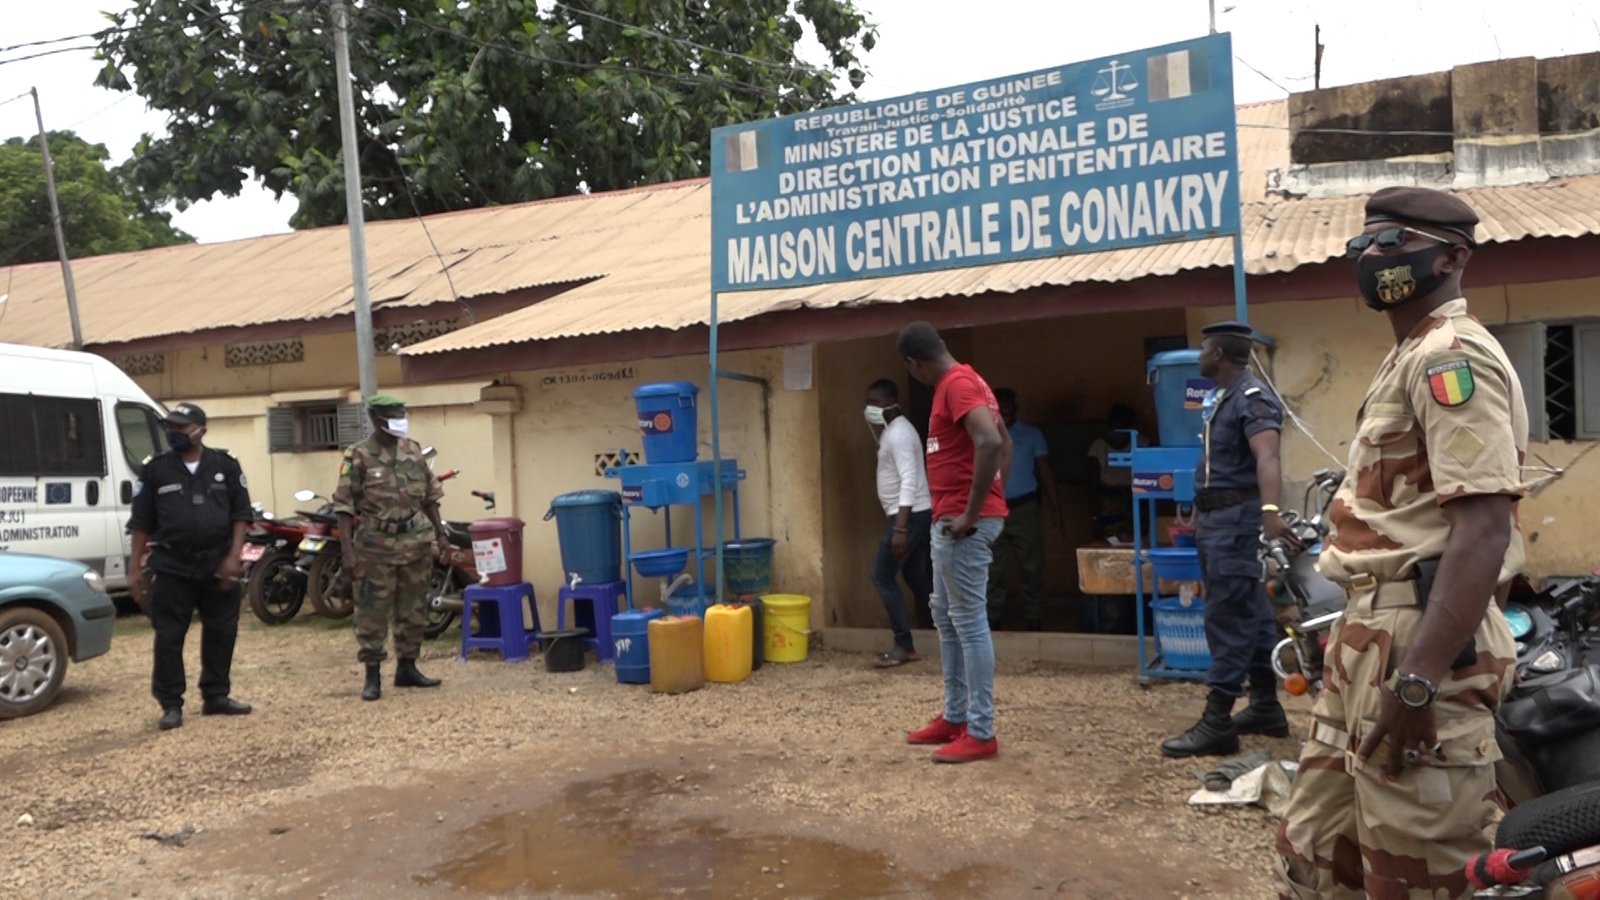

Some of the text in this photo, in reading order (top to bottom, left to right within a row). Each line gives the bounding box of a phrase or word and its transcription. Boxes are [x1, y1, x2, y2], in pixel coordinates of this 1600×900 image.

[784, 130, 898, 165] MINISTERE
[904, 125, 933, 147] DE
[941, 118, 970, 140] LA
[977, 96, 1077, 134] JUSTICE
[794, 71, 1062, 132] REPUBLIQUE DE GUINEE
[736, 131, 1226, 225] L'ADMINISTRATION PENITENTIAIRE
[779, 113, 1149, 194] DIRECTION NATIONALE DE
[728, 170, 1229, 284] MAISON CENTRALE DE CONAKRY
[0, 486, 37, 503] OPEENNE
